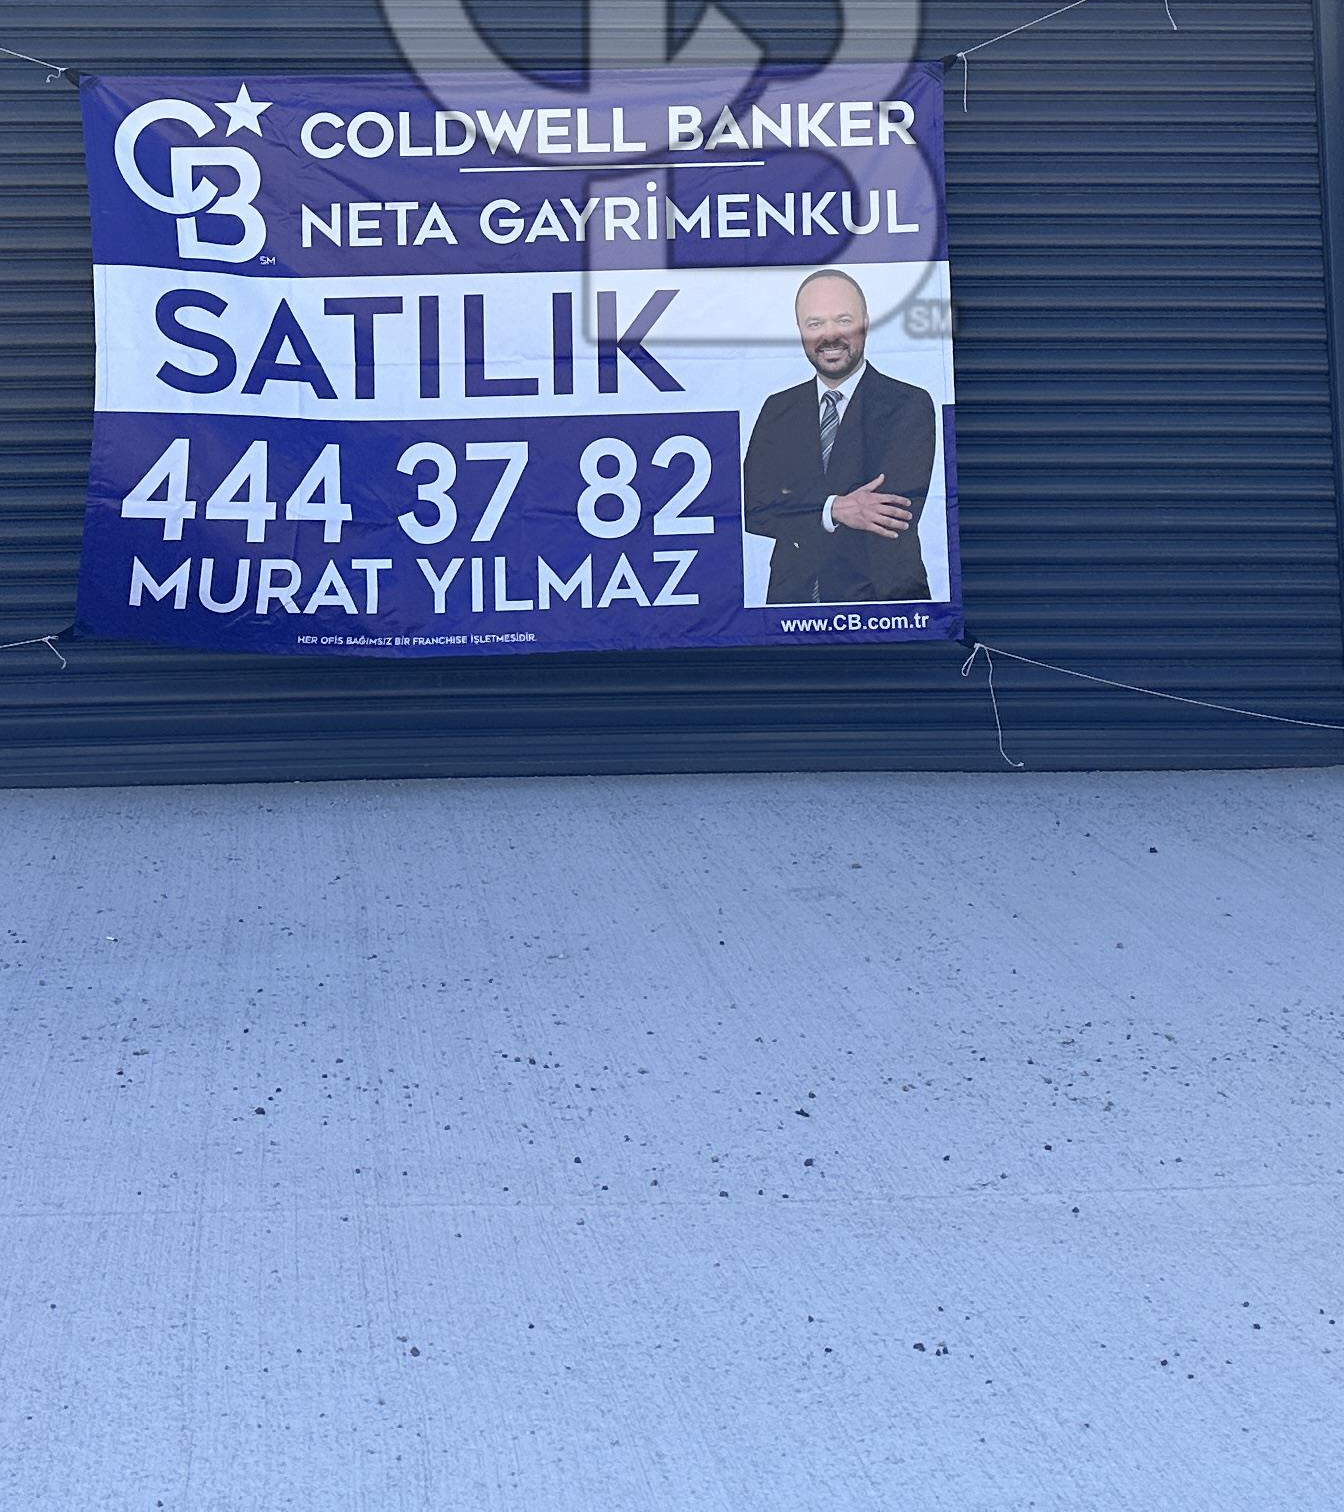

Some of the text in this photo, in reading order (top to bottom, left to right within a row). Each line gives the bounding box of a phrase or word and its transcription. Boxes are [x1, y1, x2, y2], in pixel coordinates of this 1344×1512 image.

[300, 100, 916, 159] COLDWELL BANKER
[114, 99, 267, 264] CB
[301, 181, 920, 248] NETA GAYRİMENKUL
[155, 288, 687, 400] SATILIK
[120, 435, 715, 545] 444 37 82
[128, 549, 700, 615] MURAT YILMAZ
[297, 635, 318, 645] HER
[320, 634, 344, 646] OFİS
[394, 634, 410, 646] BİR
[412, 635, 467, 646] FRANCHISE
[781, 612, 930, 633] www.CB.com.tr
